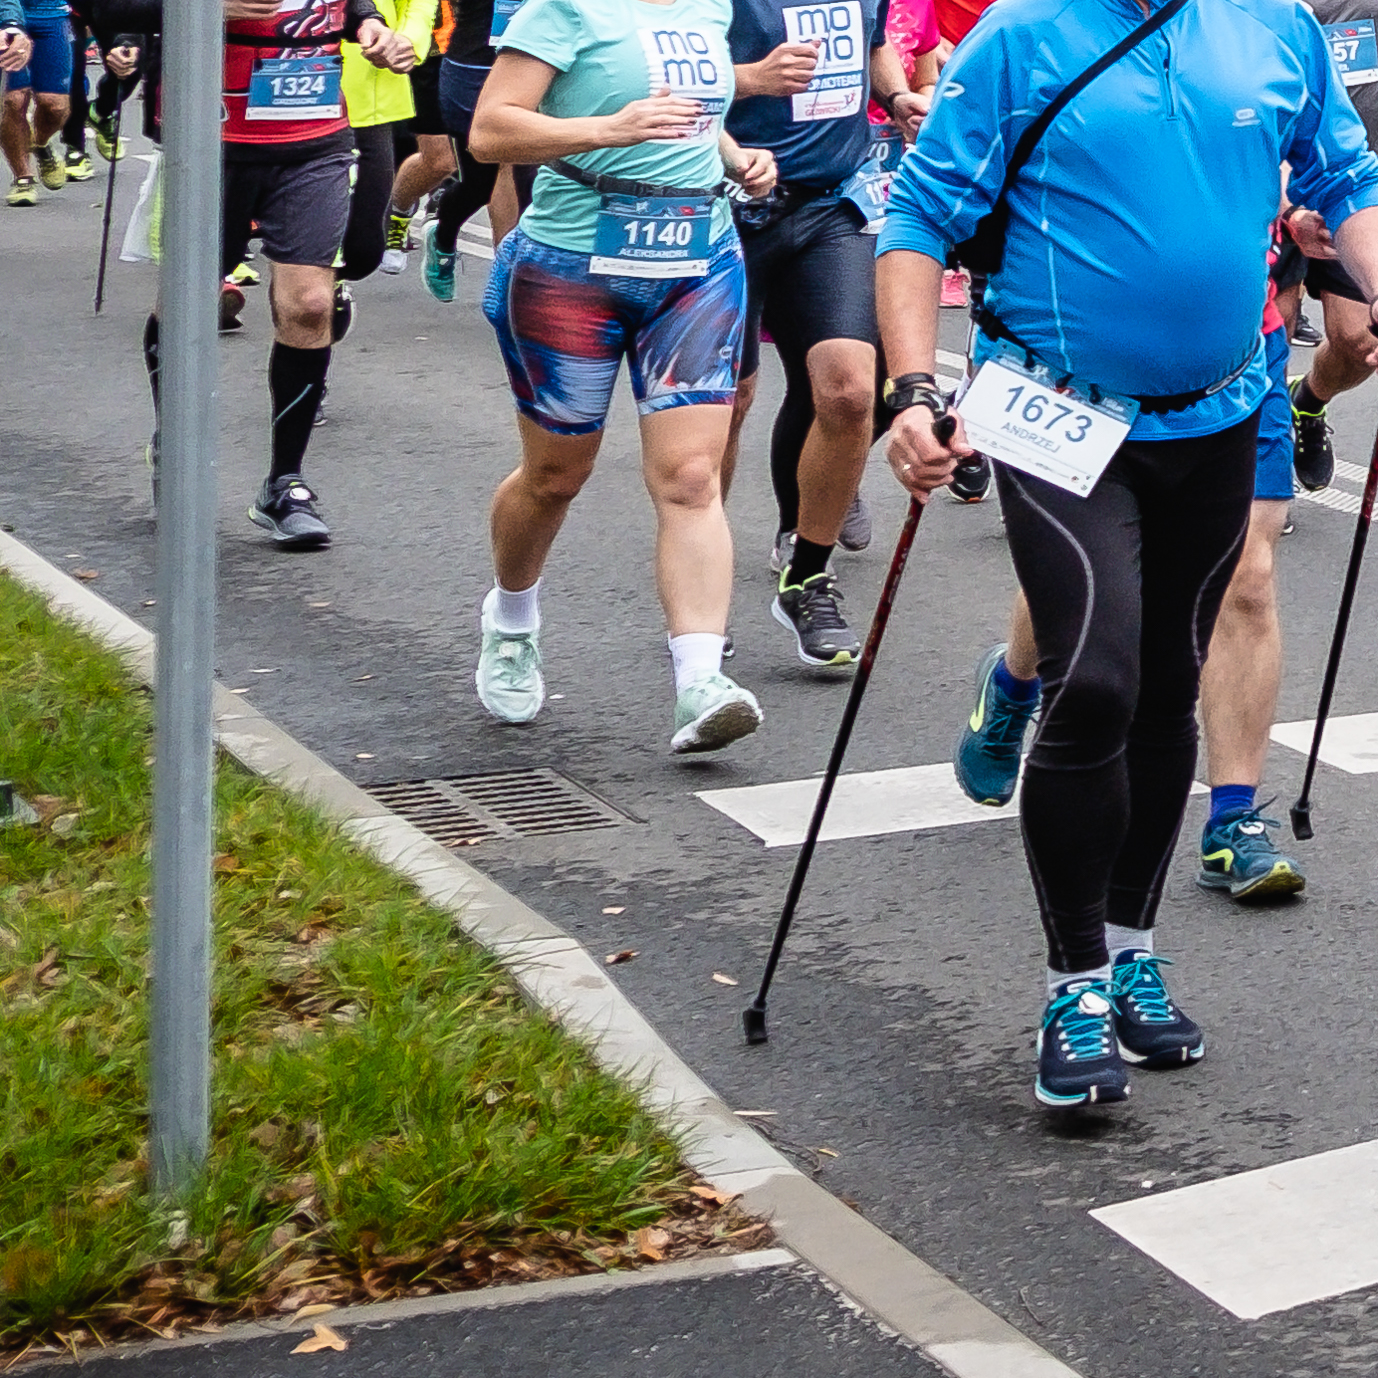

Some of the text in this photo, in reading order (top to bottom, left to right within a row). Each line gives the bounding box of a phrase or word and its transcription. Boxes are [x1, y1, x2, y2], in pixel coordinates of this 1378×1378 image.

[796, 6, 851, 36] mo
[652, 30, 709, 54] mo
[663, 59, 718, 86] mo
[270, 76, 326, 97] 1324
[624, 221, 692, 246] 1140
[1004, 385, 1093, 443] 1673
[1001, 422, 1061, 454] ANDRZEJ
